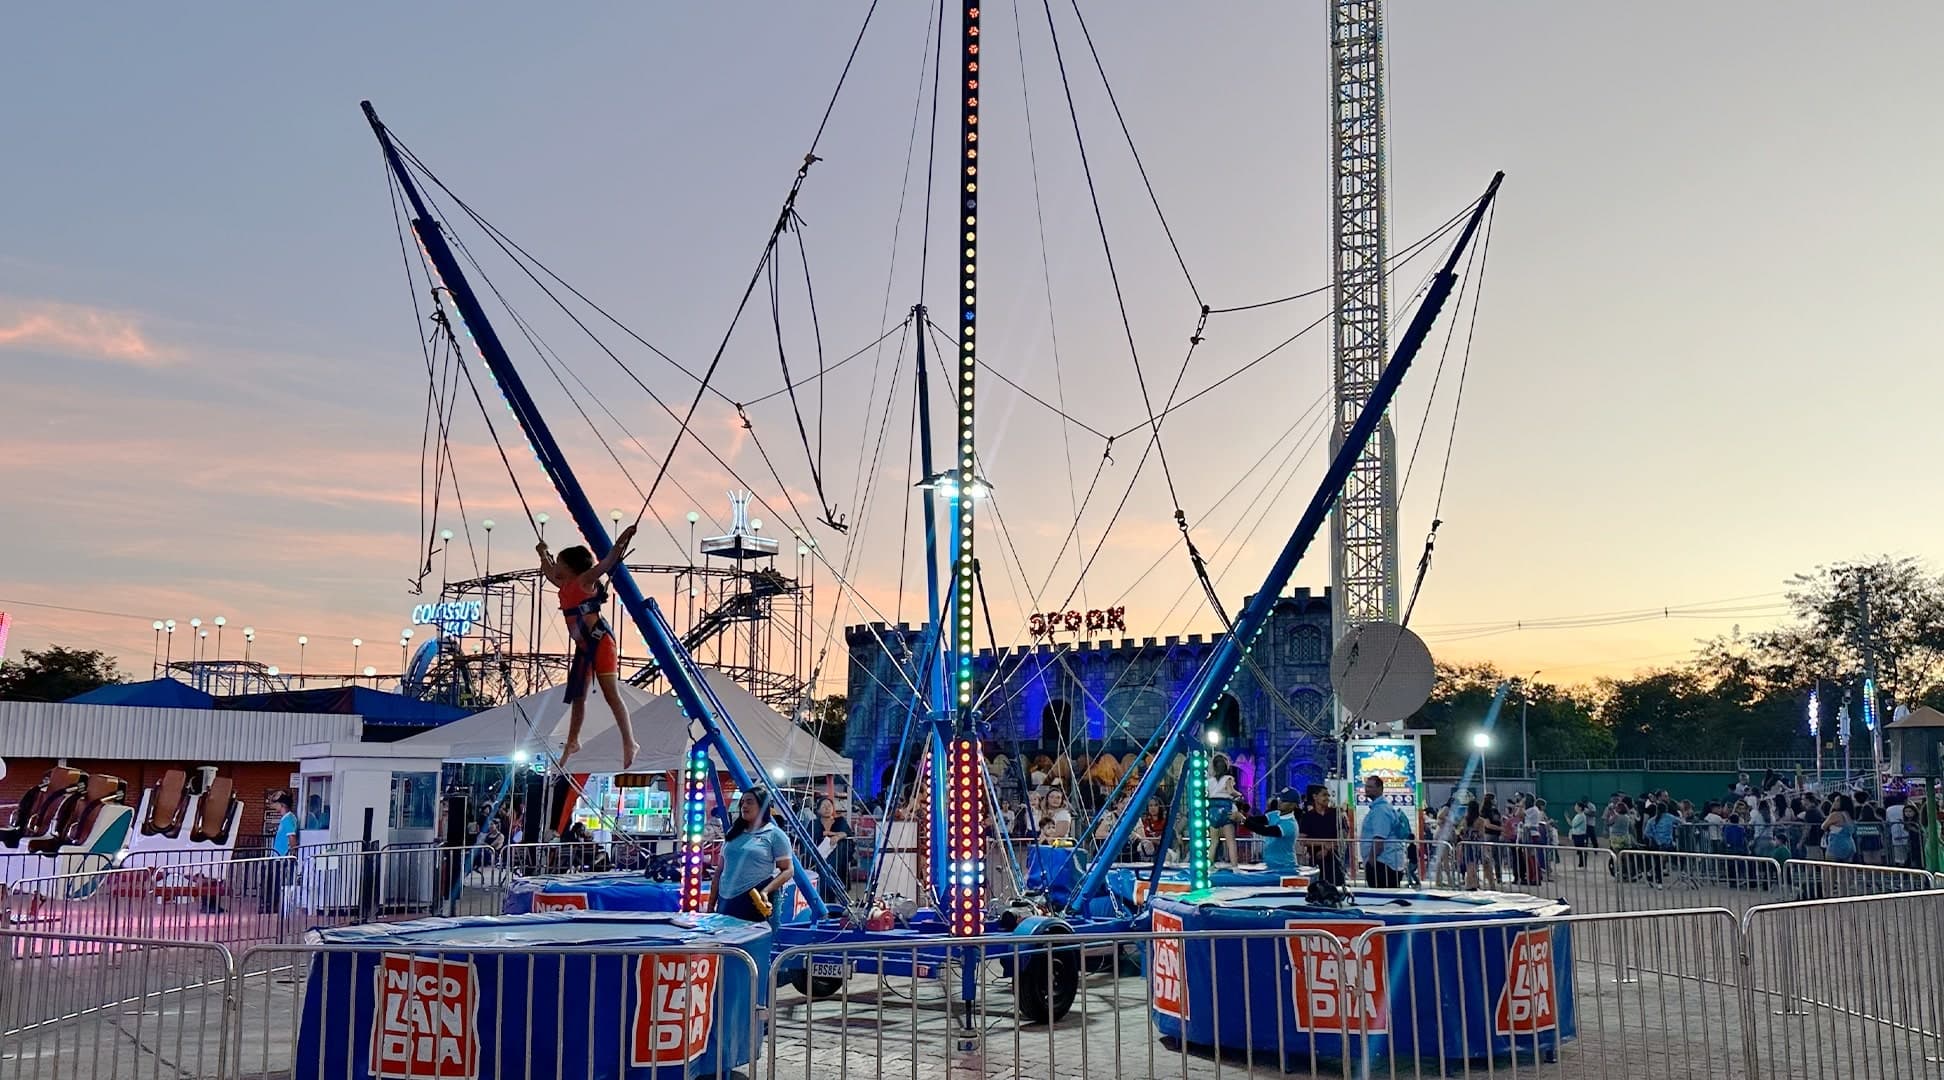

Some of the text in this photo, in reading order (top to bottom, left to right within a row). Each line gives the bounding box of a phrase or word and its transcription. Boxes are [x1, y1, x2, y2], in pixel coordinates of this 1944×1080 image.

[387, 969, 461, 998] NICO
[657, 959, 710, 982] NICO
[382, 1034, 462, 1064] DIA
